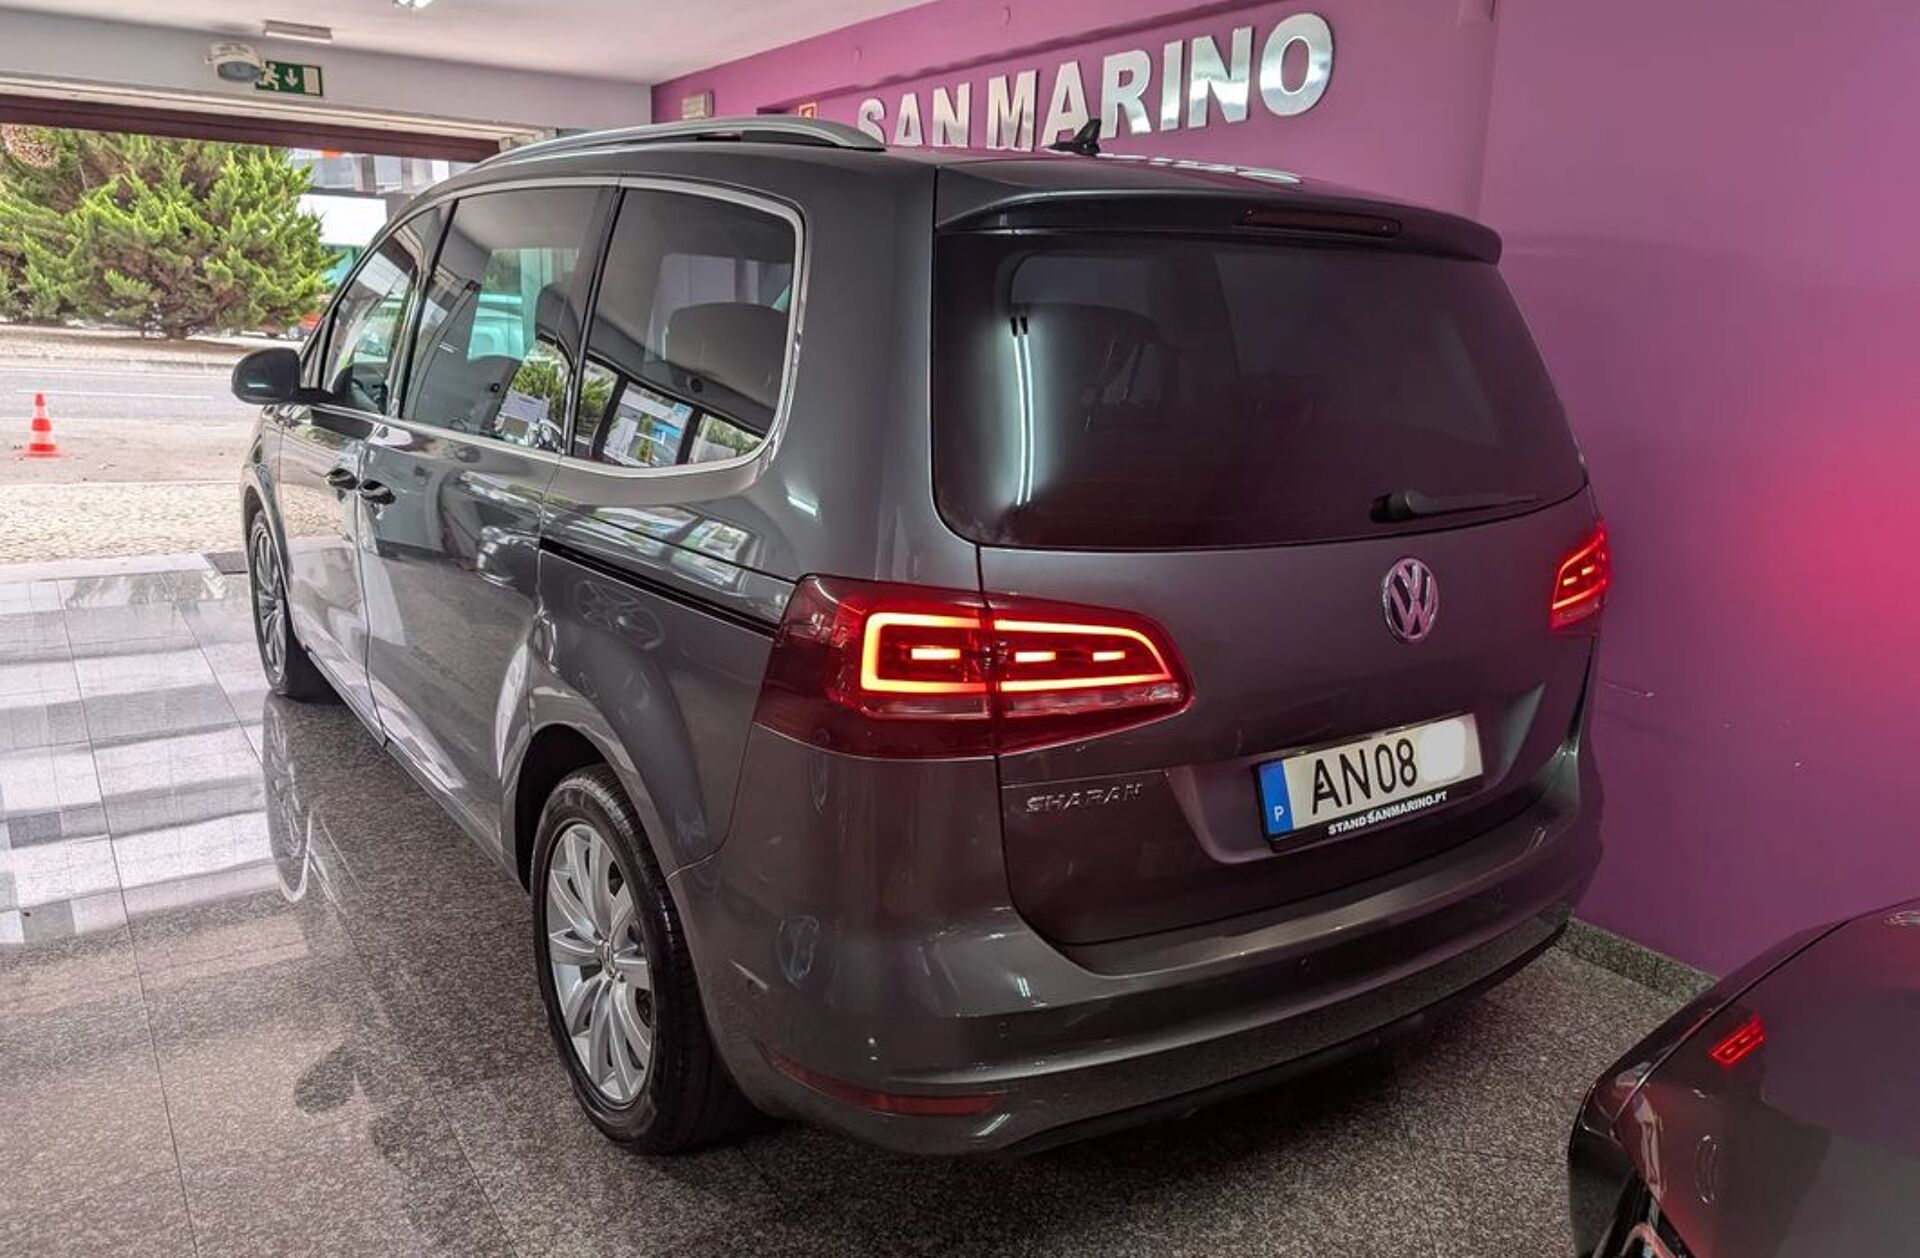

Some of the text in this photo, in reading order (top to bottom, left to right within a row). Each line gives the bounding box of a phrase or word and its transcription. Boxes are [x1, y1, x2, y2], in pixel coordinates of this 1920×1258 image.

[857, 13, 1333, 152] SAN MARINO
[1273, 804, 1285, 822] P
